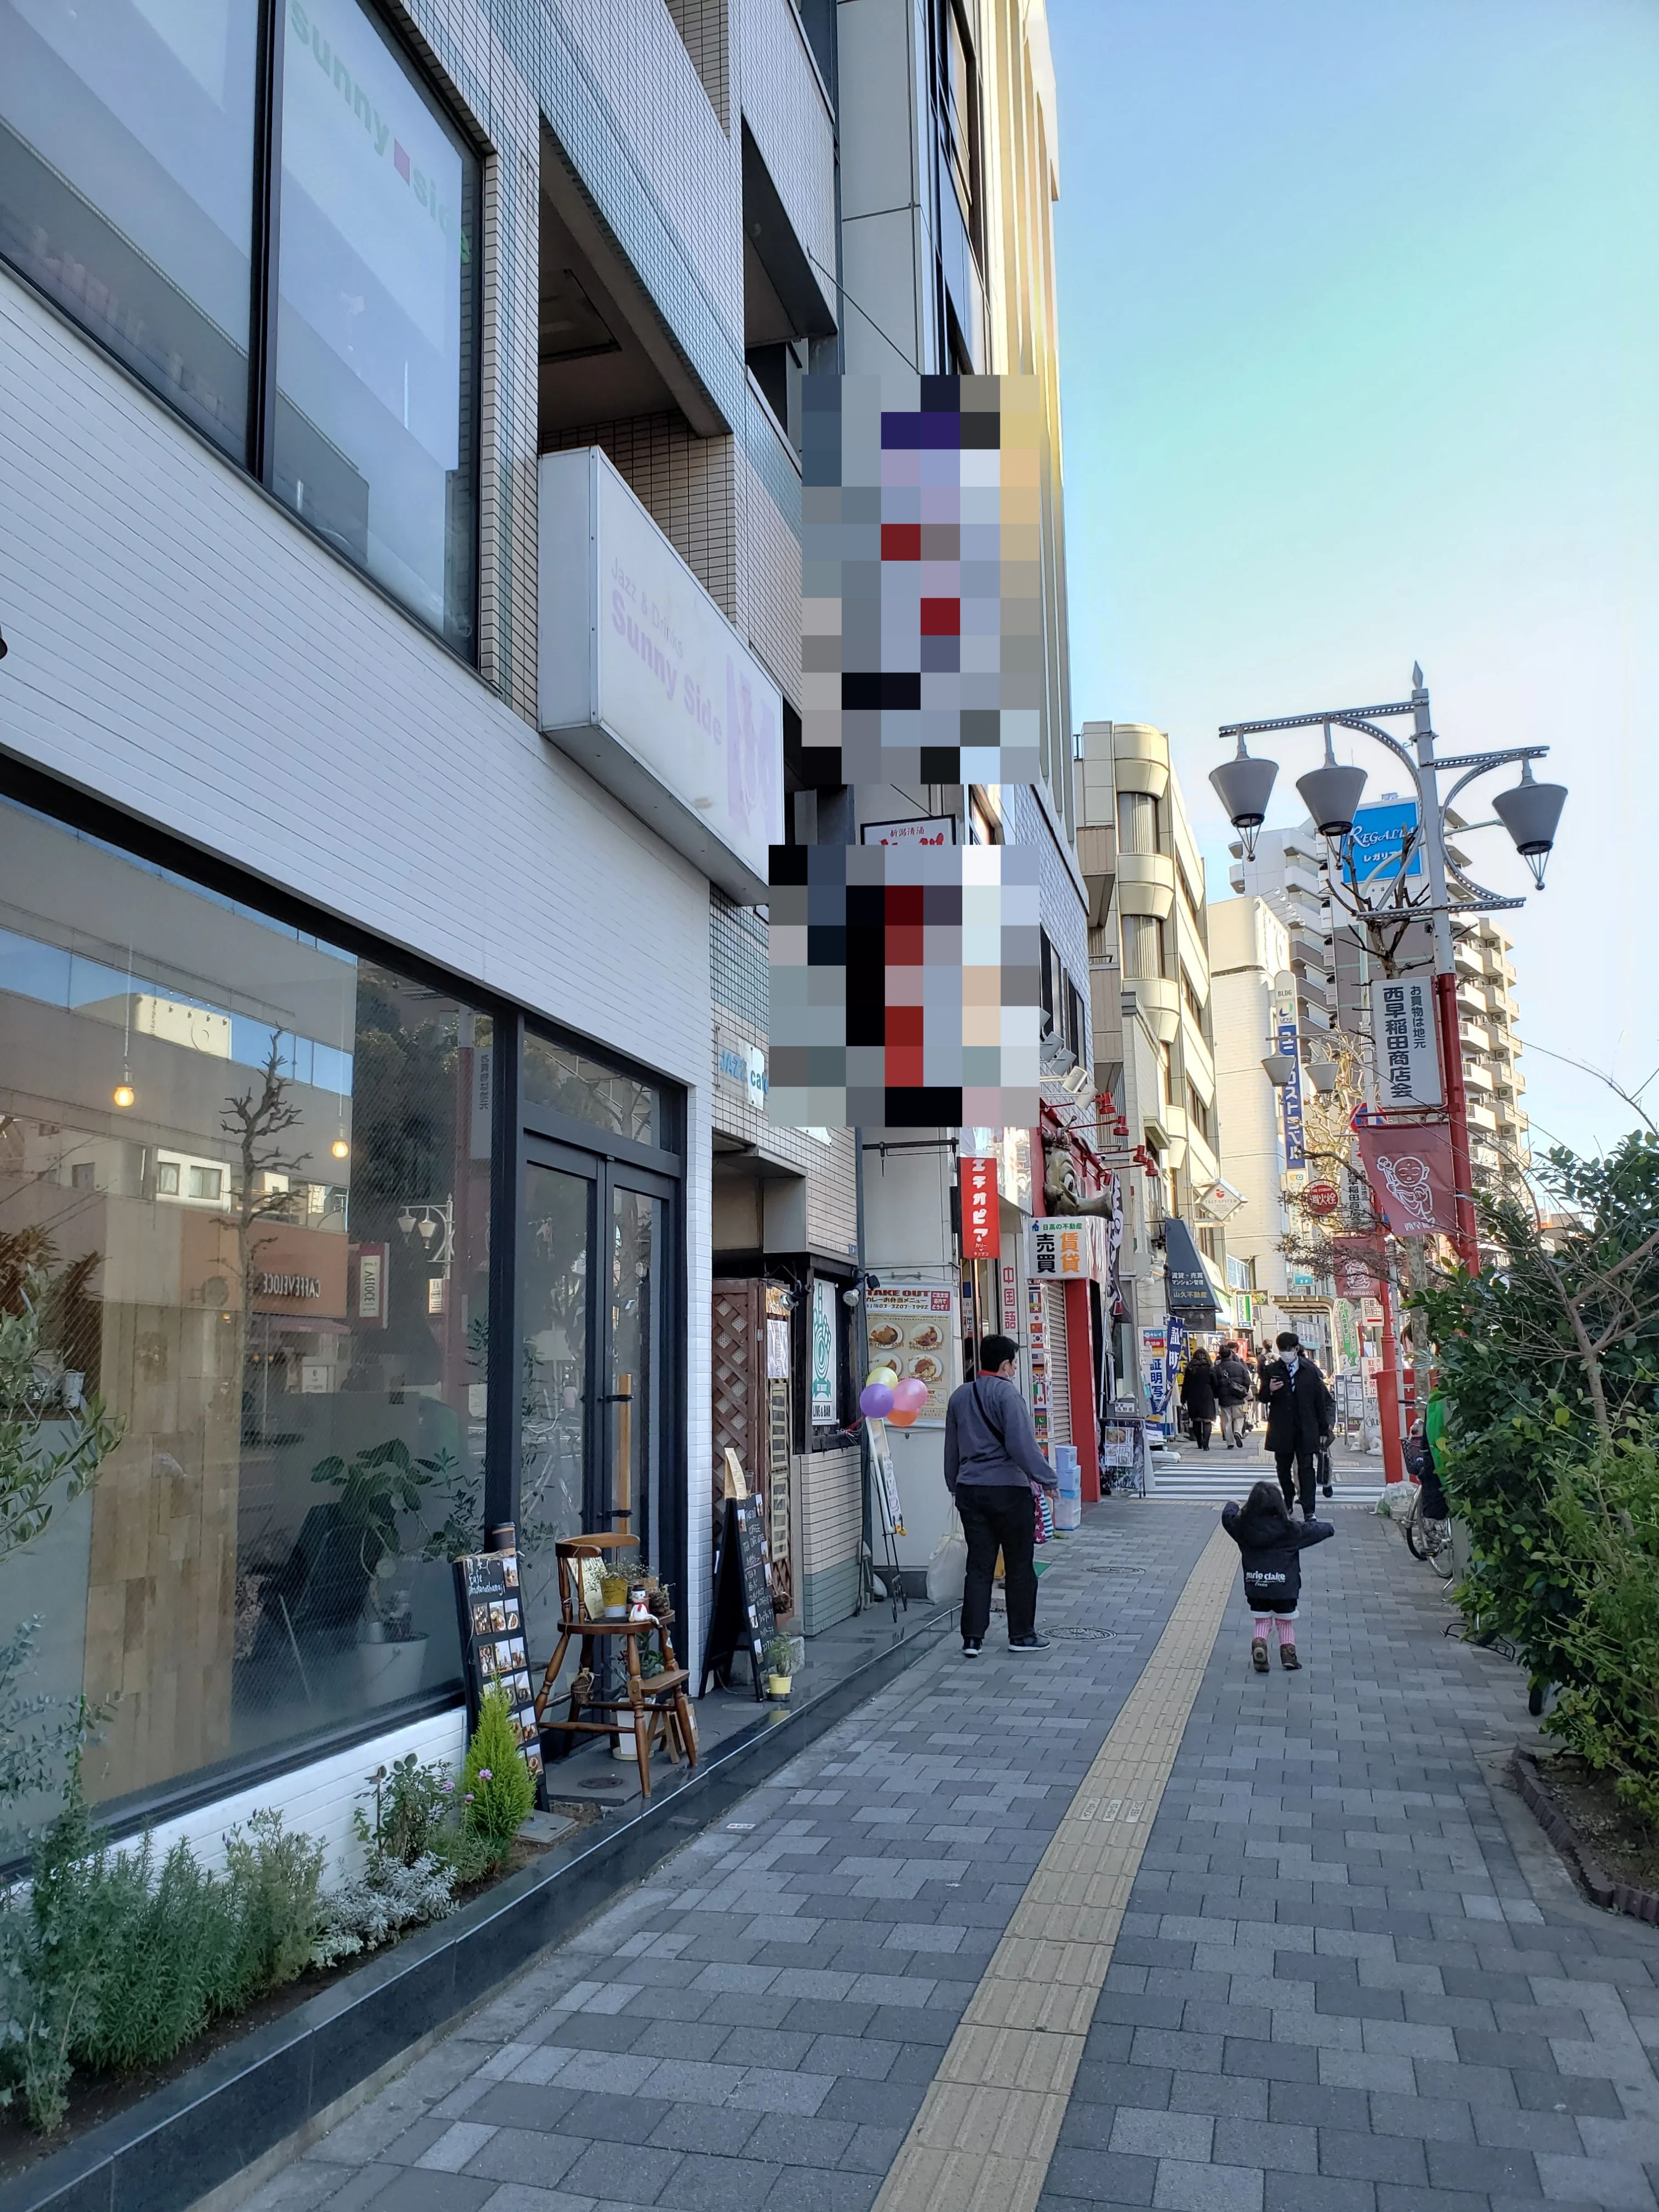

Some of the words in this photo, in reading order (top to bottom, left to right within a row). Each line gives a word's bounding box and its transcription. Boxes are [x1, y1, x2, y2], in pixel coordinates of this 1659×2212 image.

[290, 1, 390, 157] sunny
[611, 557, 637, 603] Jazz
[640, 591, 650, 616] &
[651, 599, 685, 659] Drinks
[611, 588, 678, 702] Sunny
[683, 674, 723, 746] Side
[1382, 985, 1413, 1099] 西早稲田商店会
[1409, 984, 1426, 1050] お買物は地元
[972, 1159, 989, 1242] エチオピア
[1043, 1222, 1083, 1231] 日高の不動産
[1036, 1233, 1056, 1274] 売買
[1060, 1232, 1080, 1274] 賃貸
[1003, 1266, 1016, 1329] 中国語
[1150, 1358, 1165, 1401] 証明写
[1367, 1360, 1376, 1395] 駐停禁止
[820, 1406, 823, 1417] &
[1264, 1572, 1286, 1580] claire
